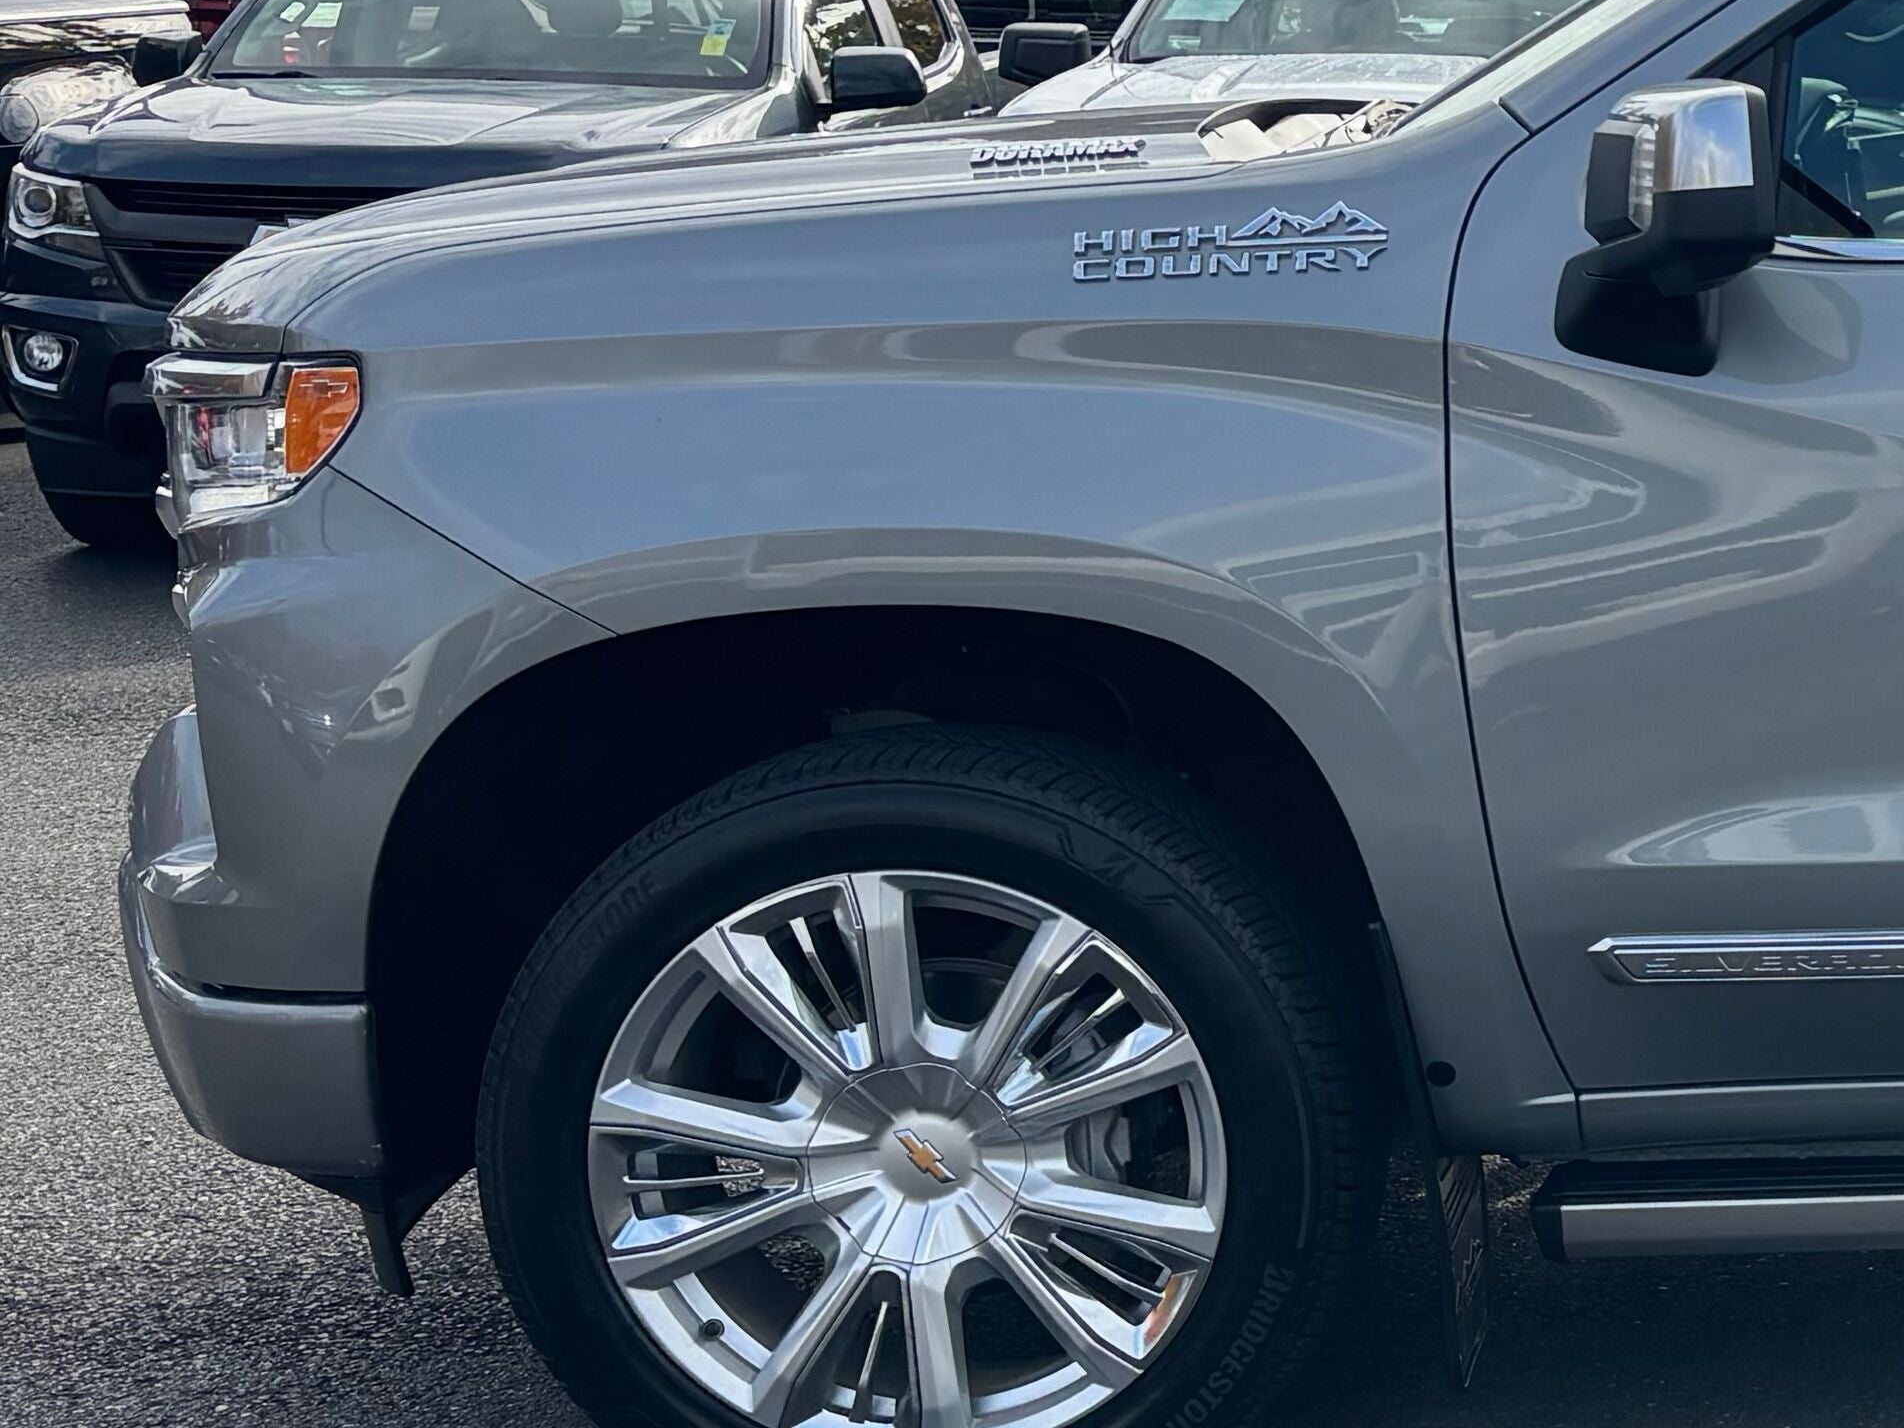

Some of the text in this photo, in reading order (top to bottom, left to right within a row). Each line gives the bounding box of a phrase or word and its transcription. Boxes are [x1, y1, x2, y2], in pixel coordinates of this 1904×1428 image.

[969, 137, 1146, 169] DURAMAX
[1073, 224, 1228, 254] HIGH
[1072, 245, 1389, 282] COUNTRY
